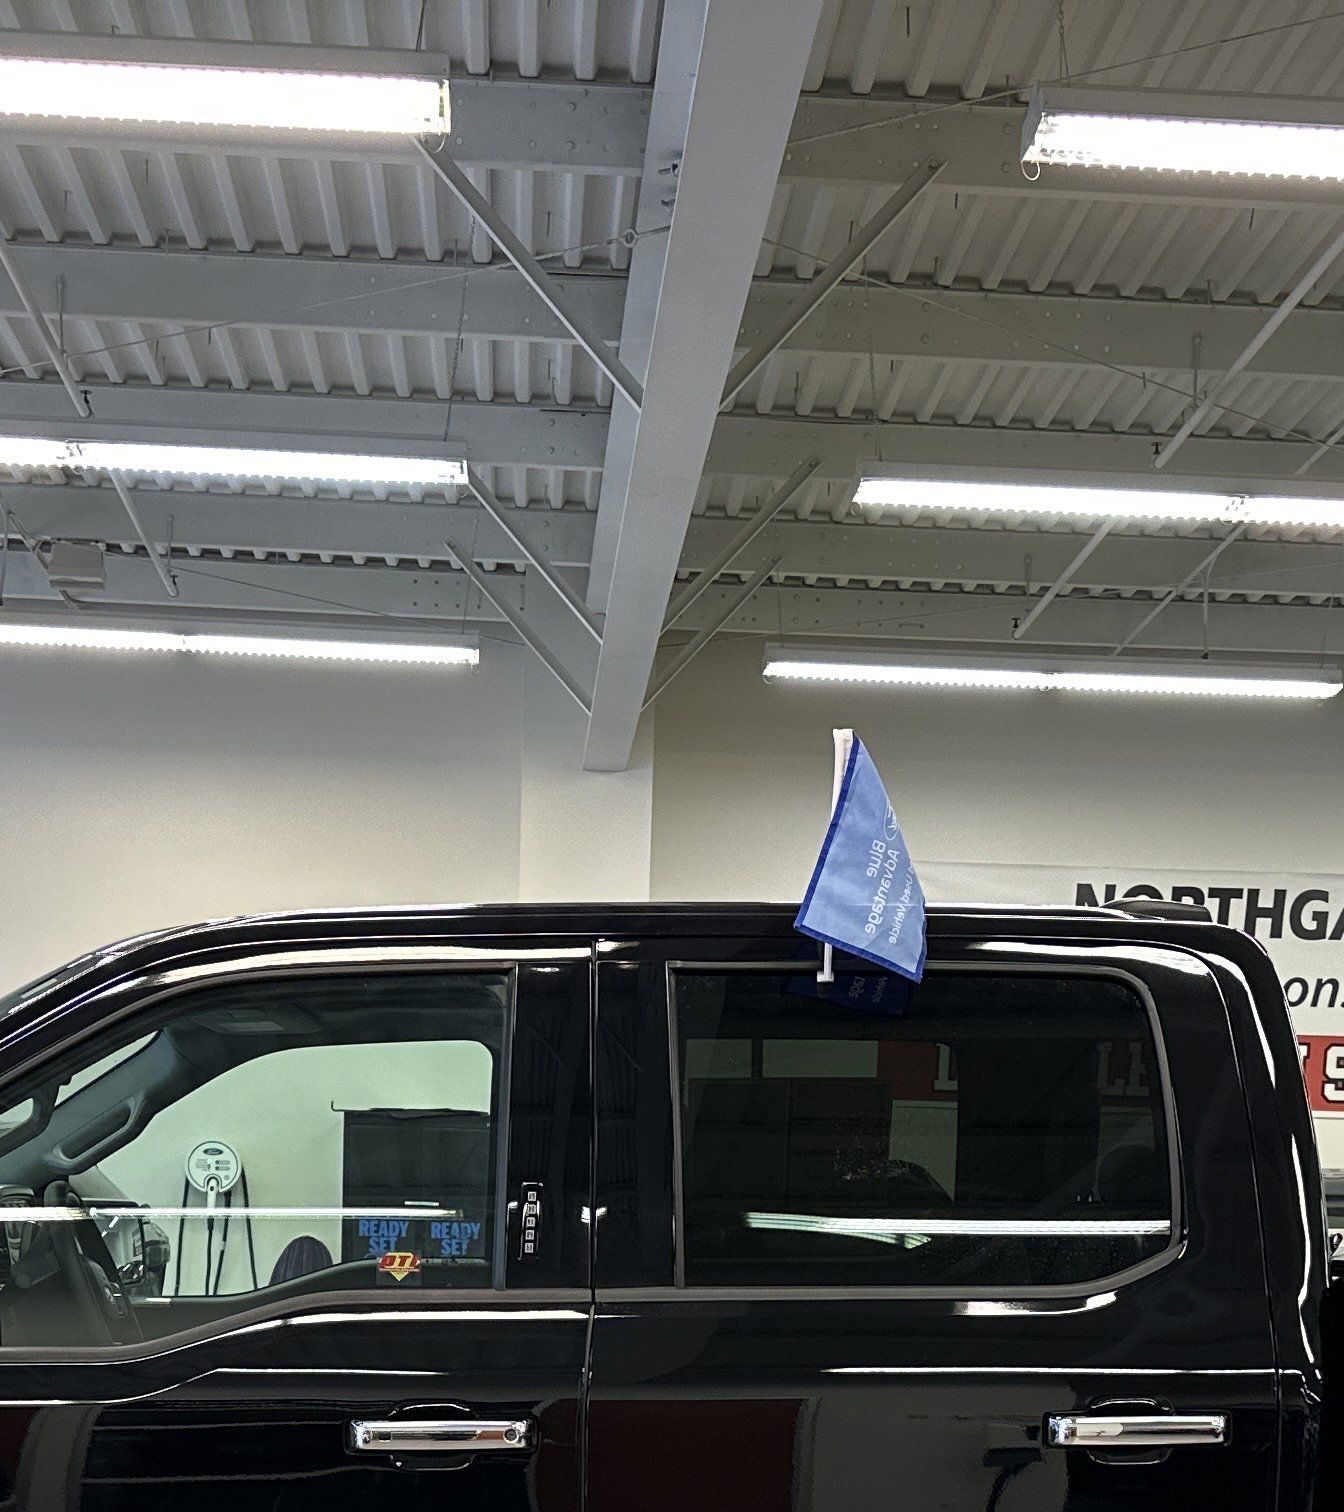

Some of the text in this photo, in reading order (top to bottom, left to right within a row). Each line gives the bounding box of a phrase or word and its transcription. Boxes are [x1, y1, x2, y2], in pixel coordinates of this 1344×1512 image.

[358, 1219, 409, 1237] READY
[431, 1222, 481, 1239] READY
[369, 1237, 398, 1254] SET
[440, 1239, 470, 1256] SET
